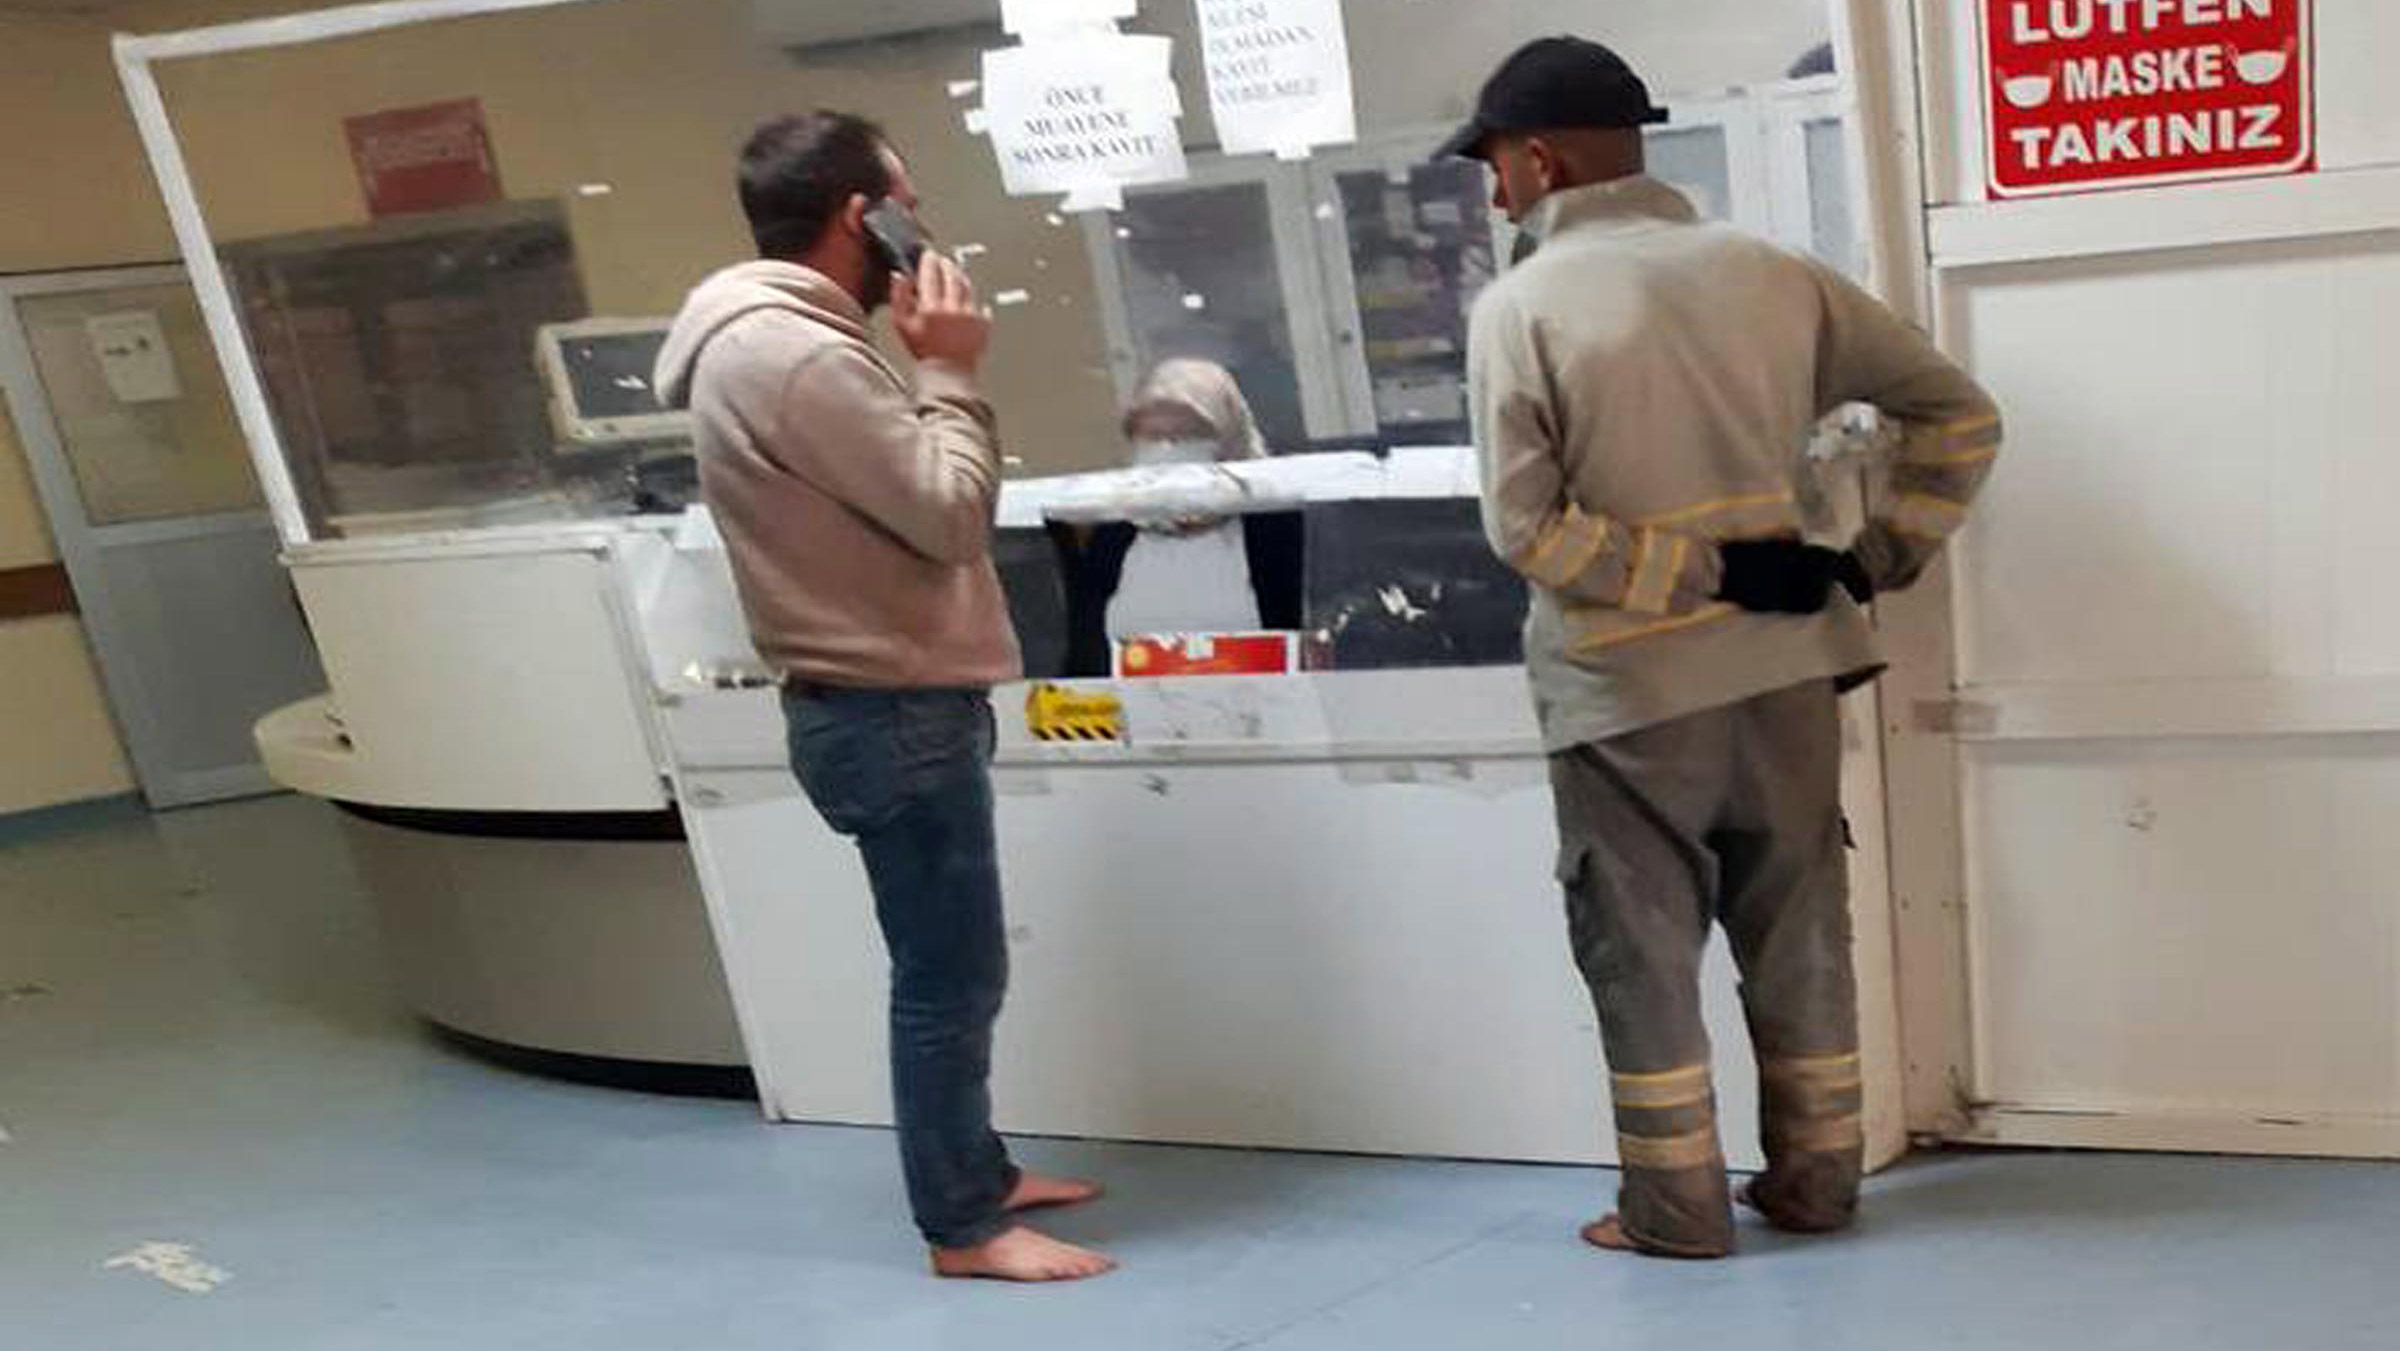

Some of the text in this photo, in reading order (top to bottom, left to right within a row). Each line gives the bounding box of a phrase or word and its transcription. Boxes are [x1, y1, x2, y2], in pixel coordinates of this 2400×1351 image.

[2063, 44, 2224, 102] MASKE
[1045, 83, 1103, 108] ÖNCE
[1023, 110, 1130, 137] MUAYENE
[2011, 104, 2283, 170] TAKINIZ
[1013, 133, 1157, 165] SONRA KAYIT
